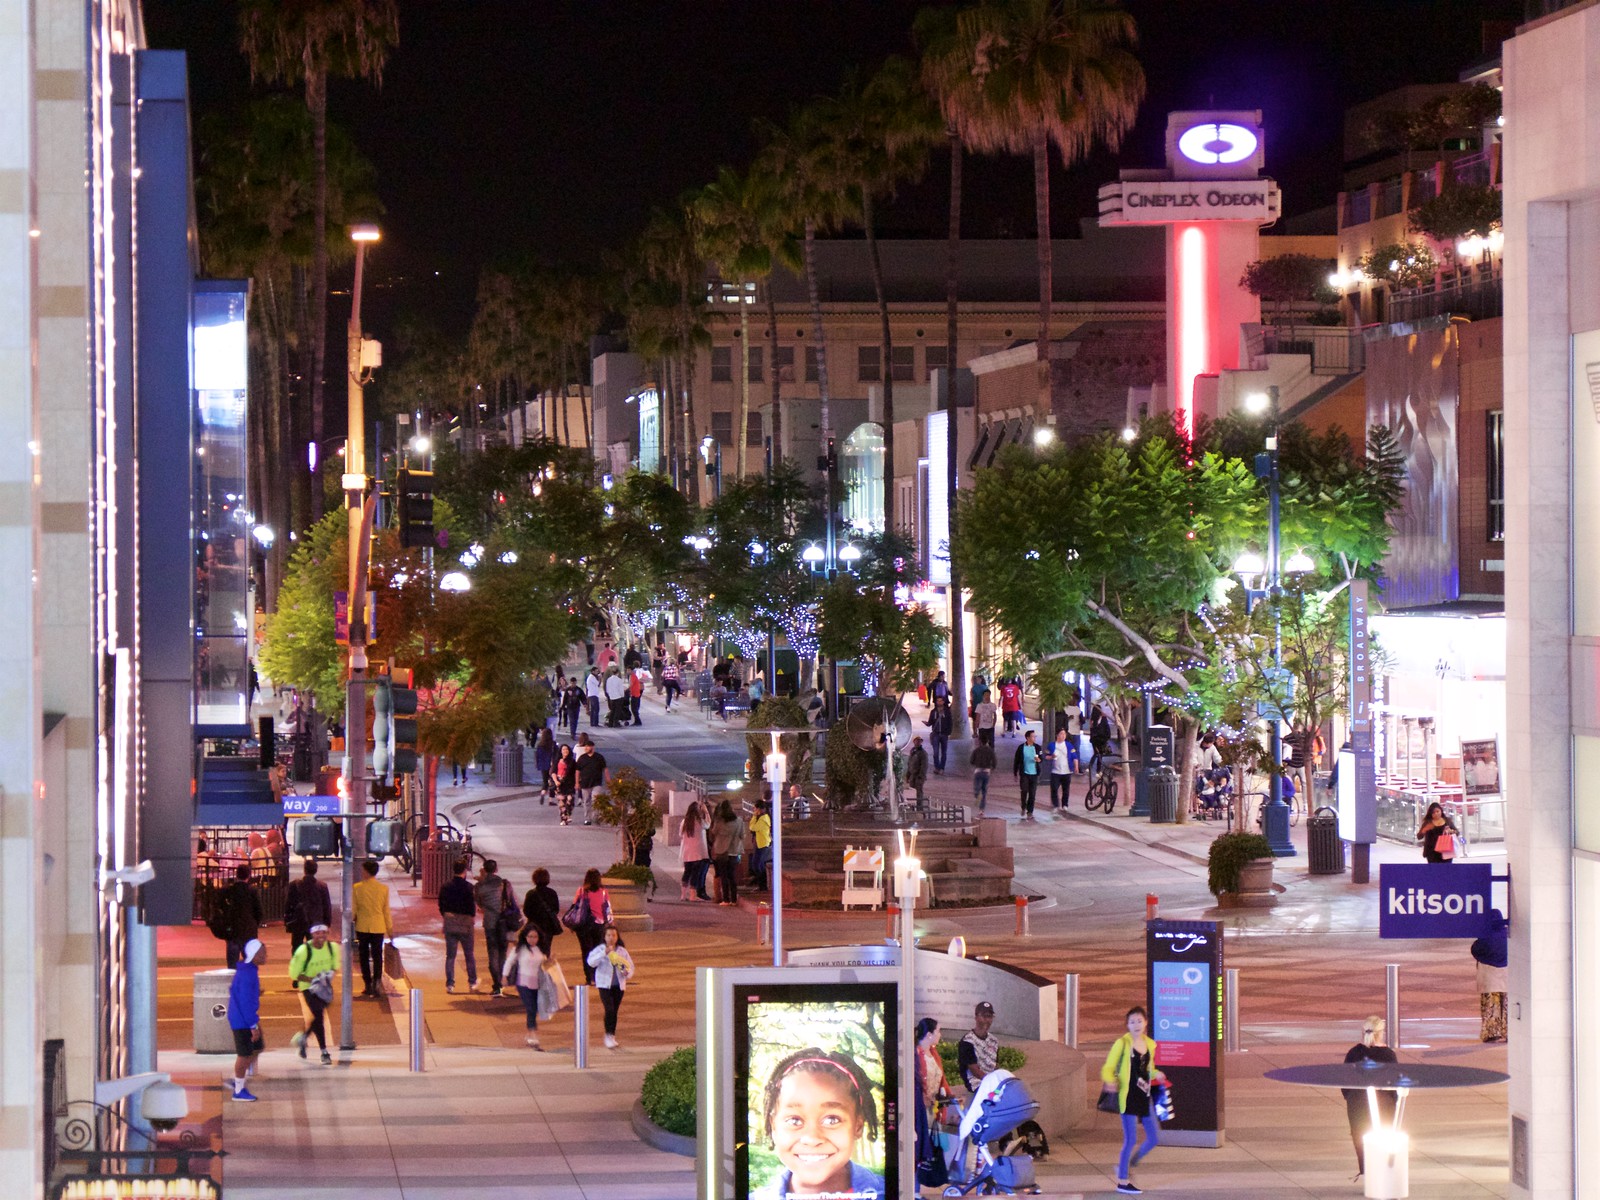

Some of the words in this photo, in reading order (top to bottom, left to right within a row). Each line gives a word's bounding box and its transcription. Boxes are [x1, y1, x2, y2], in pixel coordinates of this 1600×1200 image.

[1127, 192, 1200, 207] CINEPLEX
[1206, 191, 1265, 206] ODEON
[1356, 596, 1365, 682] BROADWAY
[1155, 746, 1163, 755] 5
[1389, 887, 1484, 914] kitson
[1159, 977, 1179, 985] YOUR
[1159, 987, 1193, 996] APPETITE
